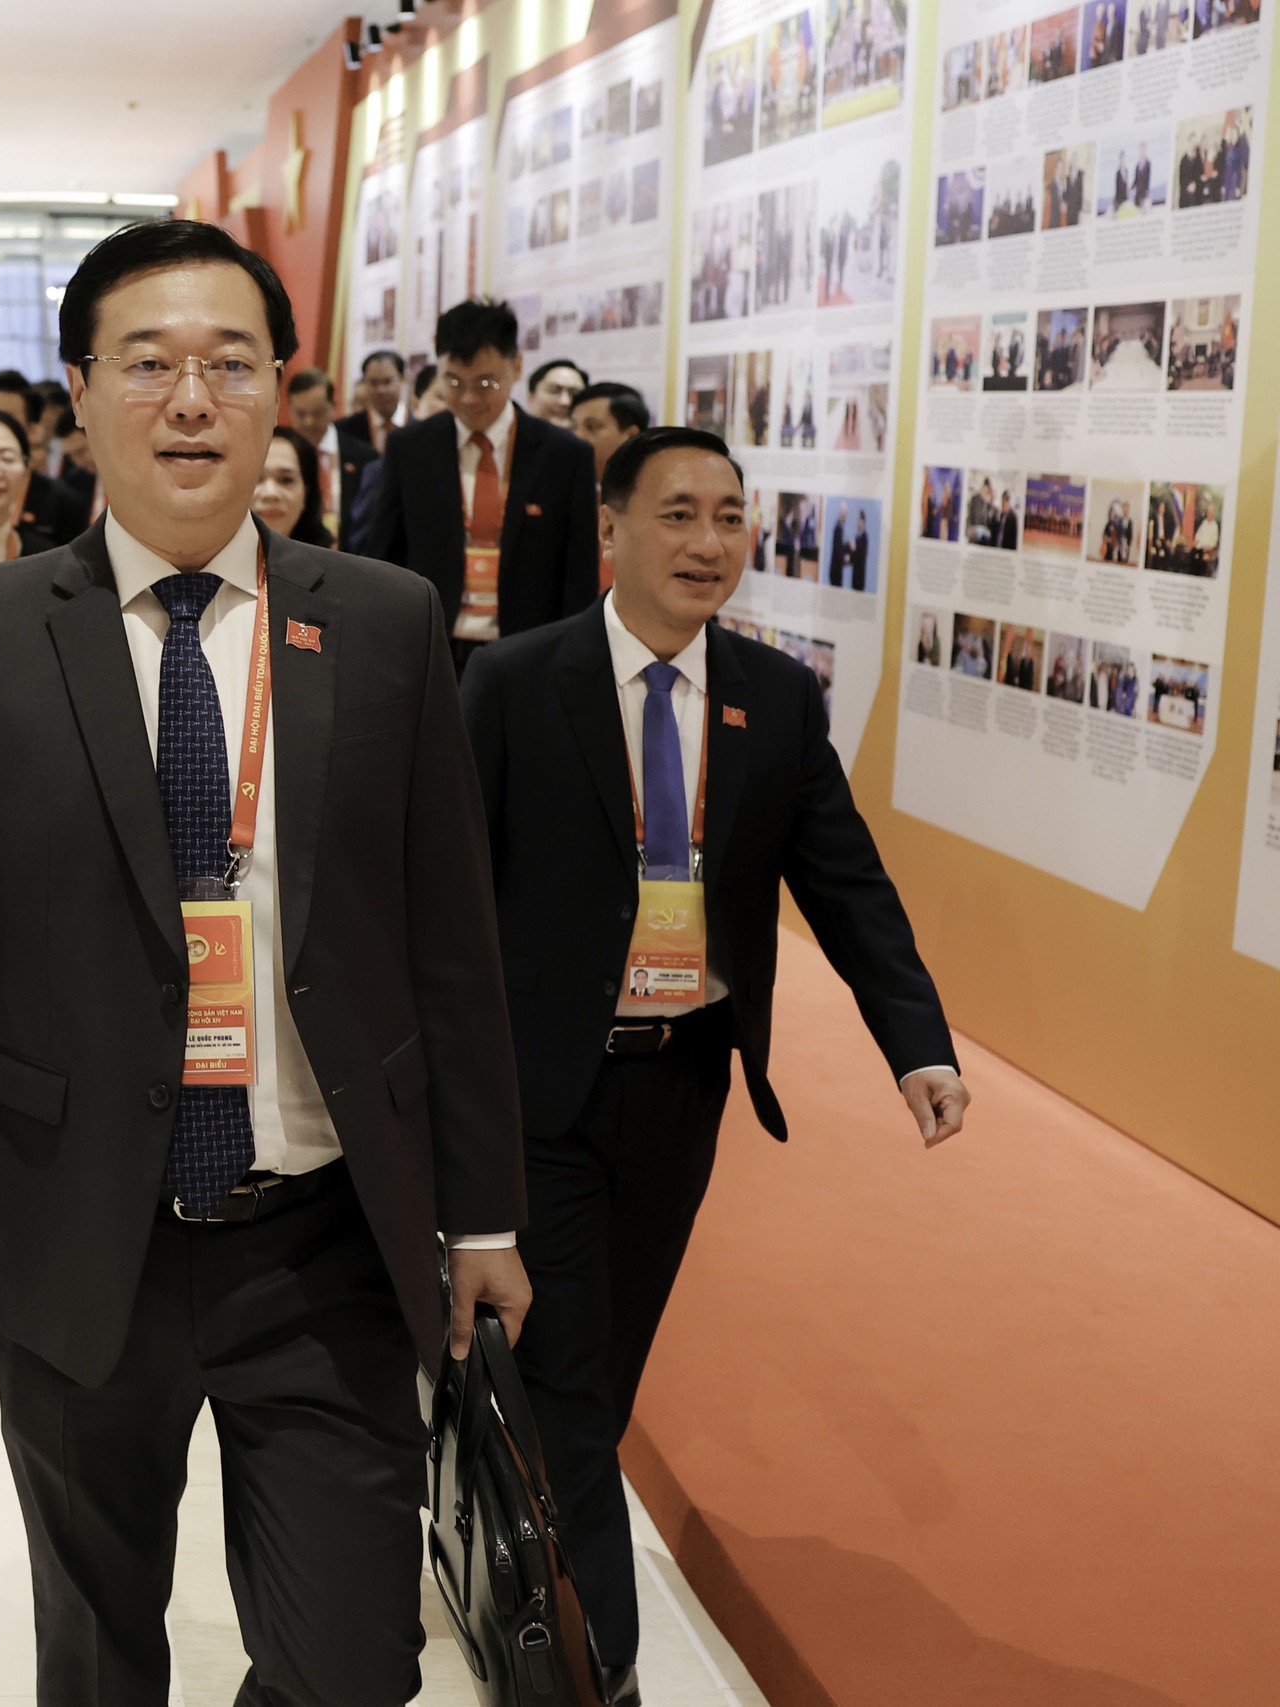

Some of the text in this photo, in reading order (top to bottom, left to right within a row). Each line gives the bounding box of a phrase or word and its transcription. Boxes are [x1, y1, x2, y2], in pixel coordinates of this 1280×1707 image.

[259, 629, 269, 655] QUỐC
[256, 656, 266, 679] TOÀN
[253, 681, 264, 700] BIỂU
[252, 702, 263, 718] ĐẠI
[250, 719, 261, 736] HỘI
[249, 737, 260, 753] ĐẠI
[195, 1059, 227, 1070] ĐẠI BIỂU
